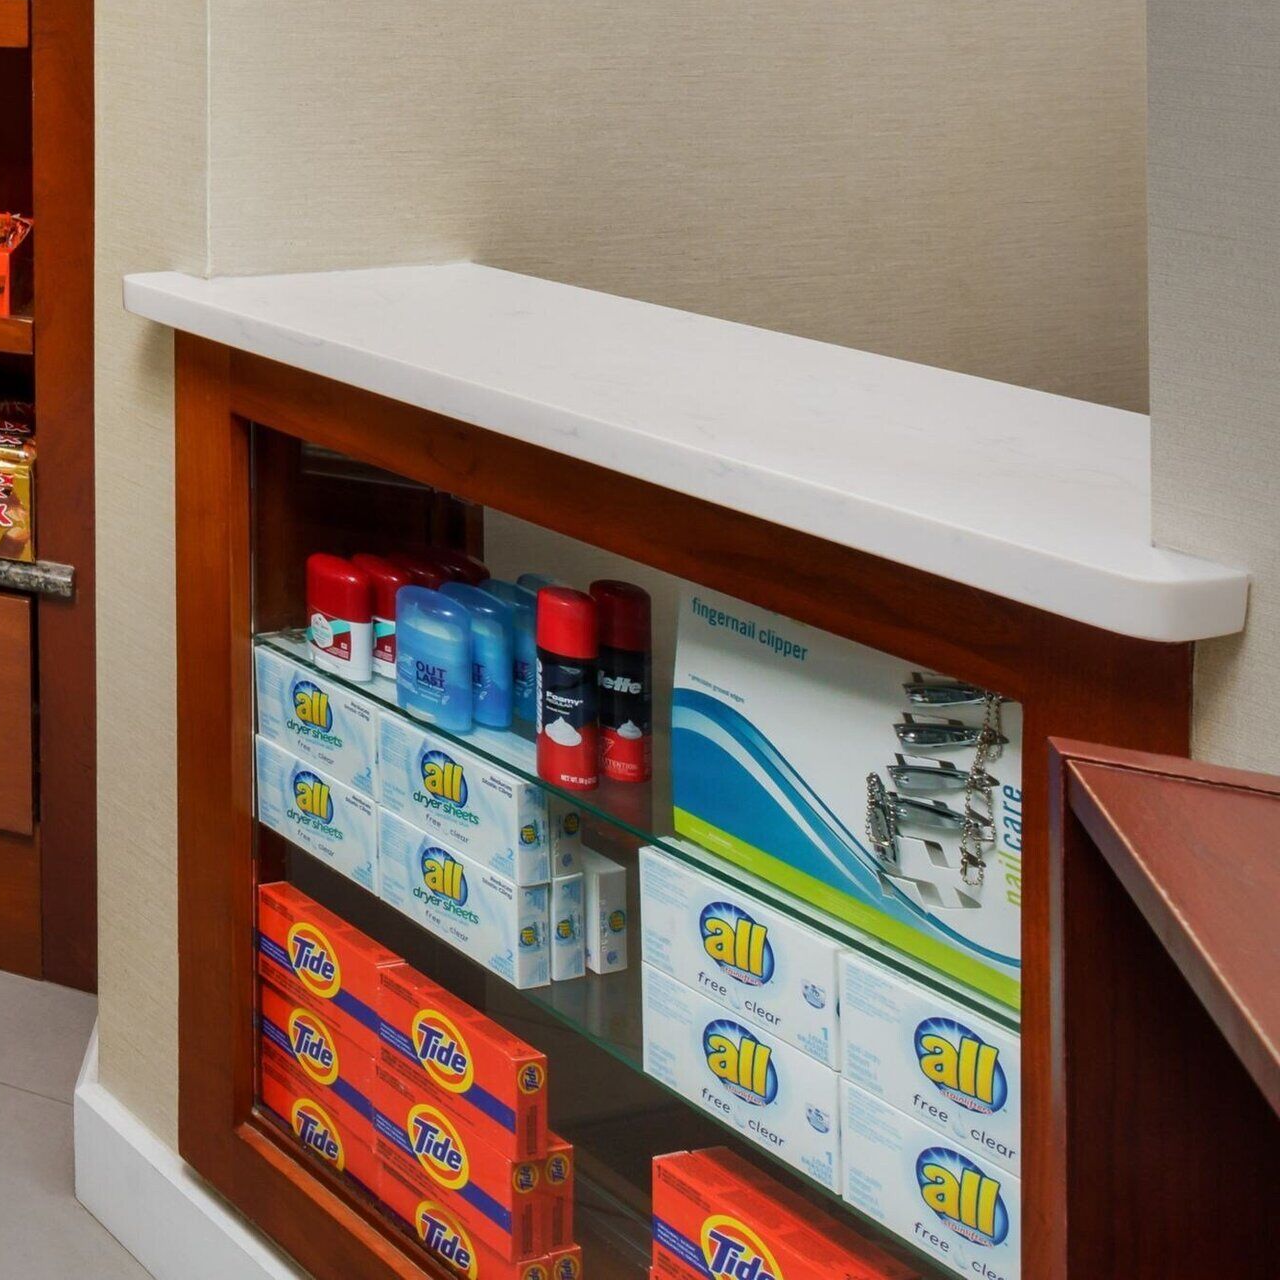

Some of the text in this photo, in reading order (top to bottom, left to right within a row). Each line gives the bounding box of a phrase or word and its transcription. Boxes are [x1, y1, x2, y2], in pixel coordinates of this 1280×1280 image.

[691, 597, 808, 662] fingernail clipper
[416, 660, 447, 679] OUT
[416, 672, 445, 689] LAST
[295, 691, 329, 727] all
[286, 719, 343, 748] dryer sheets
[296, 780, 330, 819] all
[423, 762, 464, 802] all
[286, 808, 344, 840] dryer sheets
[413, 791, 480, 825] dryer sheets
[996, 784, 1023, 908] nail care
[423, 860, 464, 901] all
[413, 887, 480, 924] dryer sheets
[291, 934, 336, 981] Tide
[703, 916, 769, 978] all
[697, 970, 782, 1027] free clear
[293, 1020, 334, 1067] Tide
[417, 1022, 468, 1074] Tide
[706, 1033, 772, 1097] all
[919, 1035, 998, 1105] all
[296, 1110, 339, 1160] Tide
[701, 1088, 785, 1148] free clear
[913, 1093, 1017, 1160] free clear
[412, 1116, 463, 1172] Tide
[920, 1162, 1001, 1238] all
[420, 1211, 471, 1272] Tide
[914, 1221, 950, 1253] free
